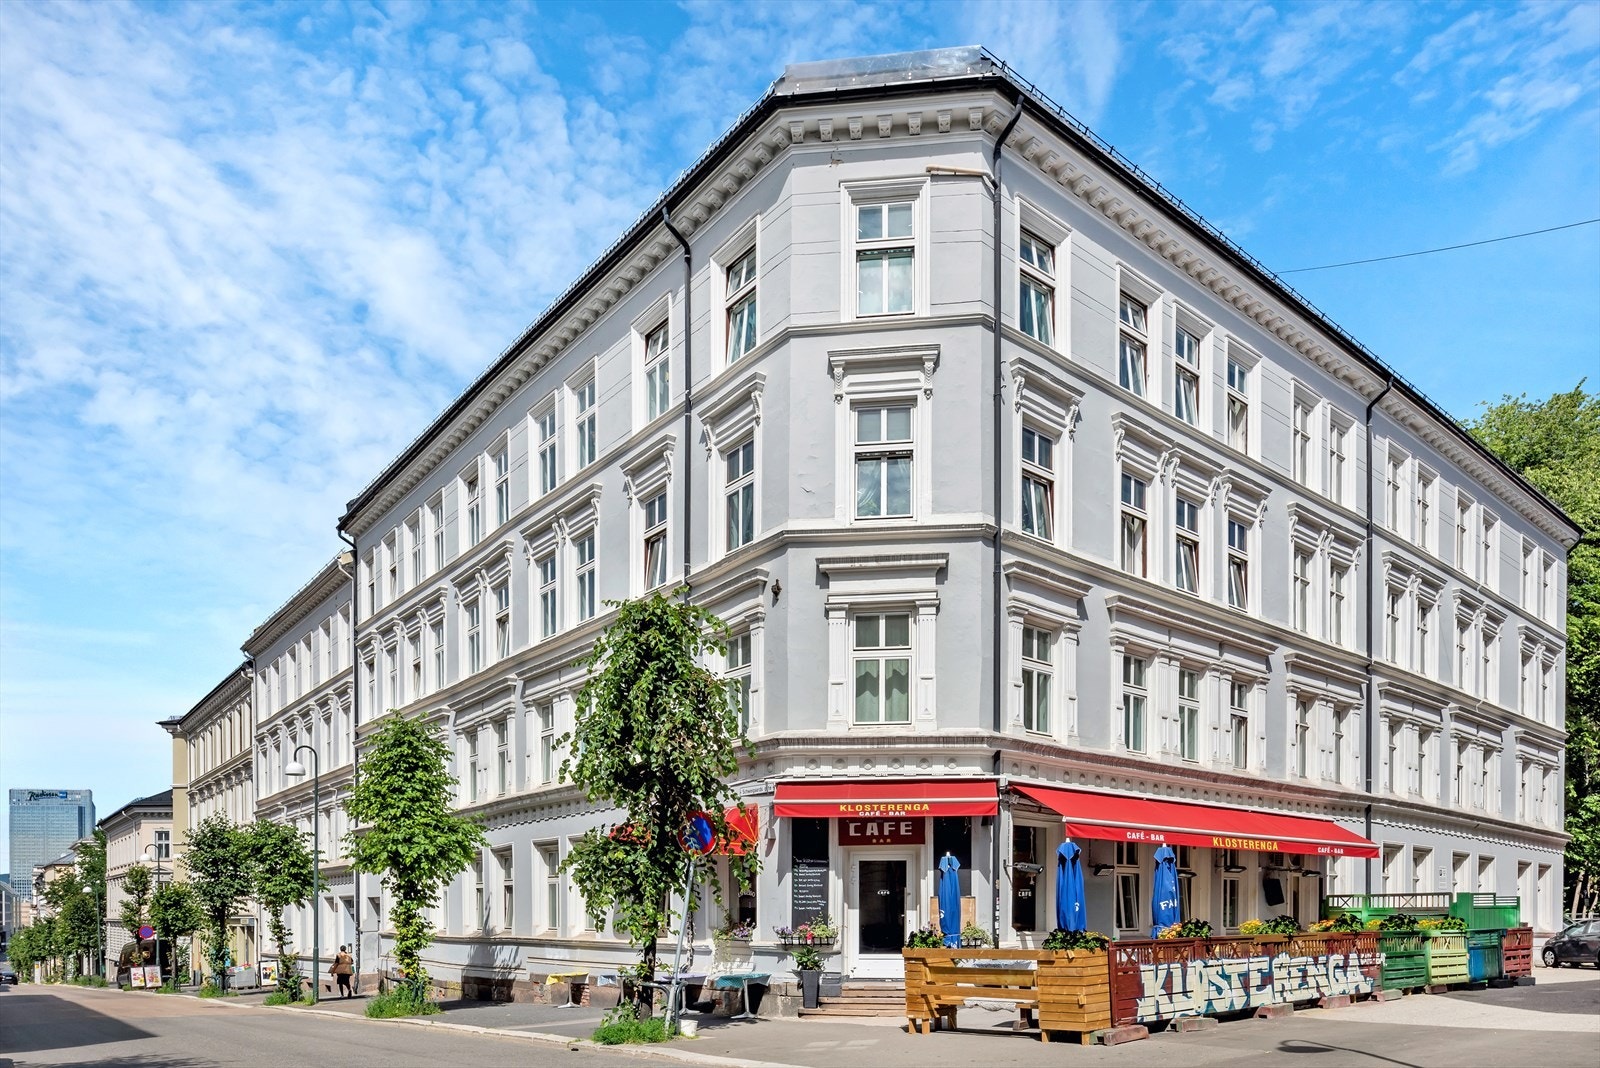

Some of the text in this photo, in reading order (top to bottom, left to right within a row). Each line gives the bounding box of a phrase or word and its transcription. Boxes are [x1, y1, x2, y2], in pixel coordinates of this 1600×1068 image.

[28, 790, 59, 801] Radisson
[839, 803, 930, 812] KLOSTERENGA
[849, 821, 913, 836] CAFE
[1126, 831, 1145, 840] CAFÉ
[1150, 833, 1165, 842] BAR
[1212, 836, 1279, 851] KLOSTERENGA
[1317, 846, 1331, 854] CAFÉ
[1334, 847, 1344, 855] BAR
